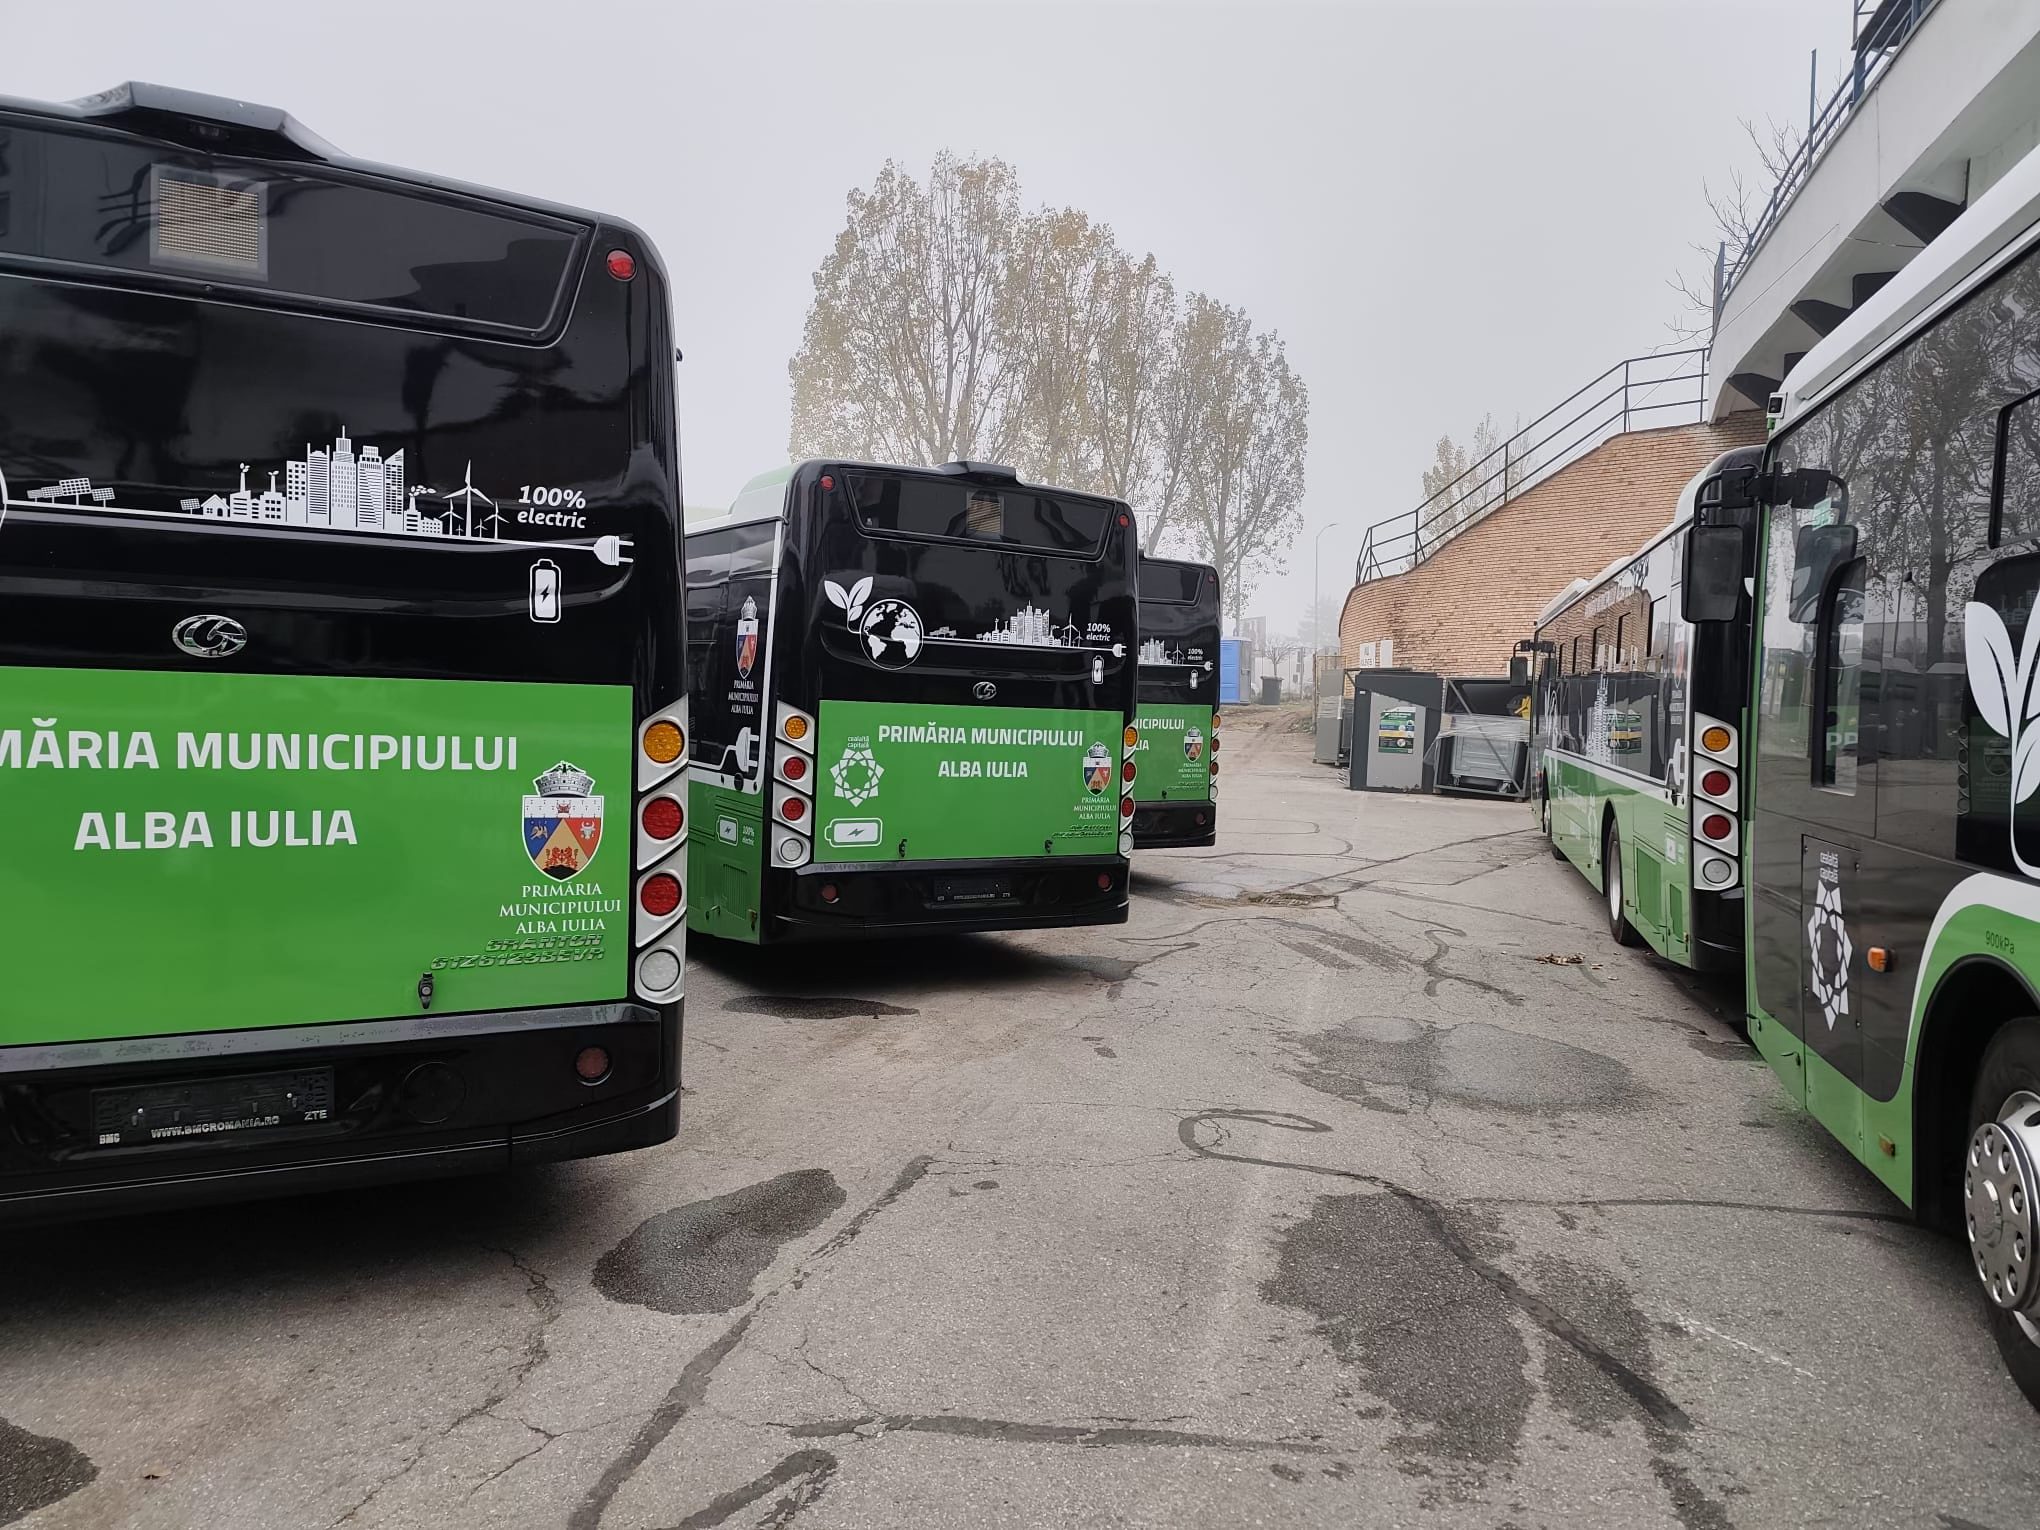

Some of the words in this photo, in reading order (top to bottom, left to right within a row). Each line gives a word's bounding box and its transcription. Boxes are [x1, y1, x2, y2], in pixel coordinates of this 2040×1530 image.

[518, 485, 586, 509] 100%
[517, 507, 587, 529] electric
[1086, 622, 1111, 633] 100%
[1086, 632, 1111, 642] electric
[878, 721, 967, 744] PRIMĂRIA
[971, 727, 1084, 747] MUNICIPIULUI
[177, 732, 517, 771] MUNICIPIULUI
[938, 760, 982, 778] ALBA
[986, 761, 1028, 778] IULIA
[1078, 812, 1094, 820] ALBA
[74, 811, 214, 851] ALBA
[231, 809, 358, 848] IULIA
[521, 881, 603, 898] PRIMĂRIA
[499, 899, 622, 918] MUNICIPIULUI
[515, 919, 557, 935] ALBA
[562, 917, 606, 932] IULIA
[485, 934, 604, 953] GRANTON
[1985, 930, 2015, 954] 900kPa
[304, 1109, 328, 1121] ZTE
[151, 1115, 281, 1139] WWW.BMCROMANIA.RO
